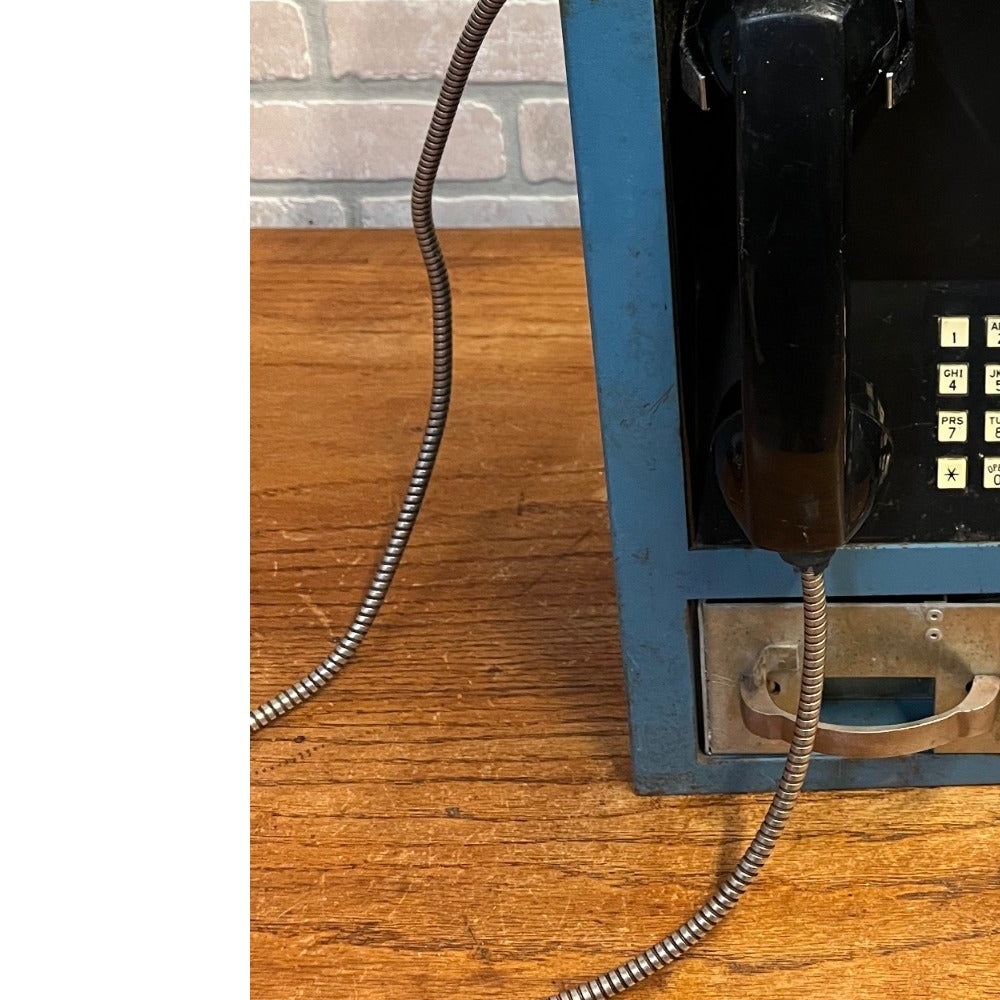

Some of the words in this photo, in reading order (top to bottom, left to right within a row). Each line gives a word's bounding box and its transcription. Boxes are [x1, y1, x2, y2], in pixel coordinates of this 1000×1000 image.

[952, 332, 957, 343] 1
[944, 369, 963, 378] GHI
[949, 380, 957, 391] 4
[941, 417, 964, 425] PRS
[948, 427, 956, 439] 7
[994, 474, 1000, 486] 0
